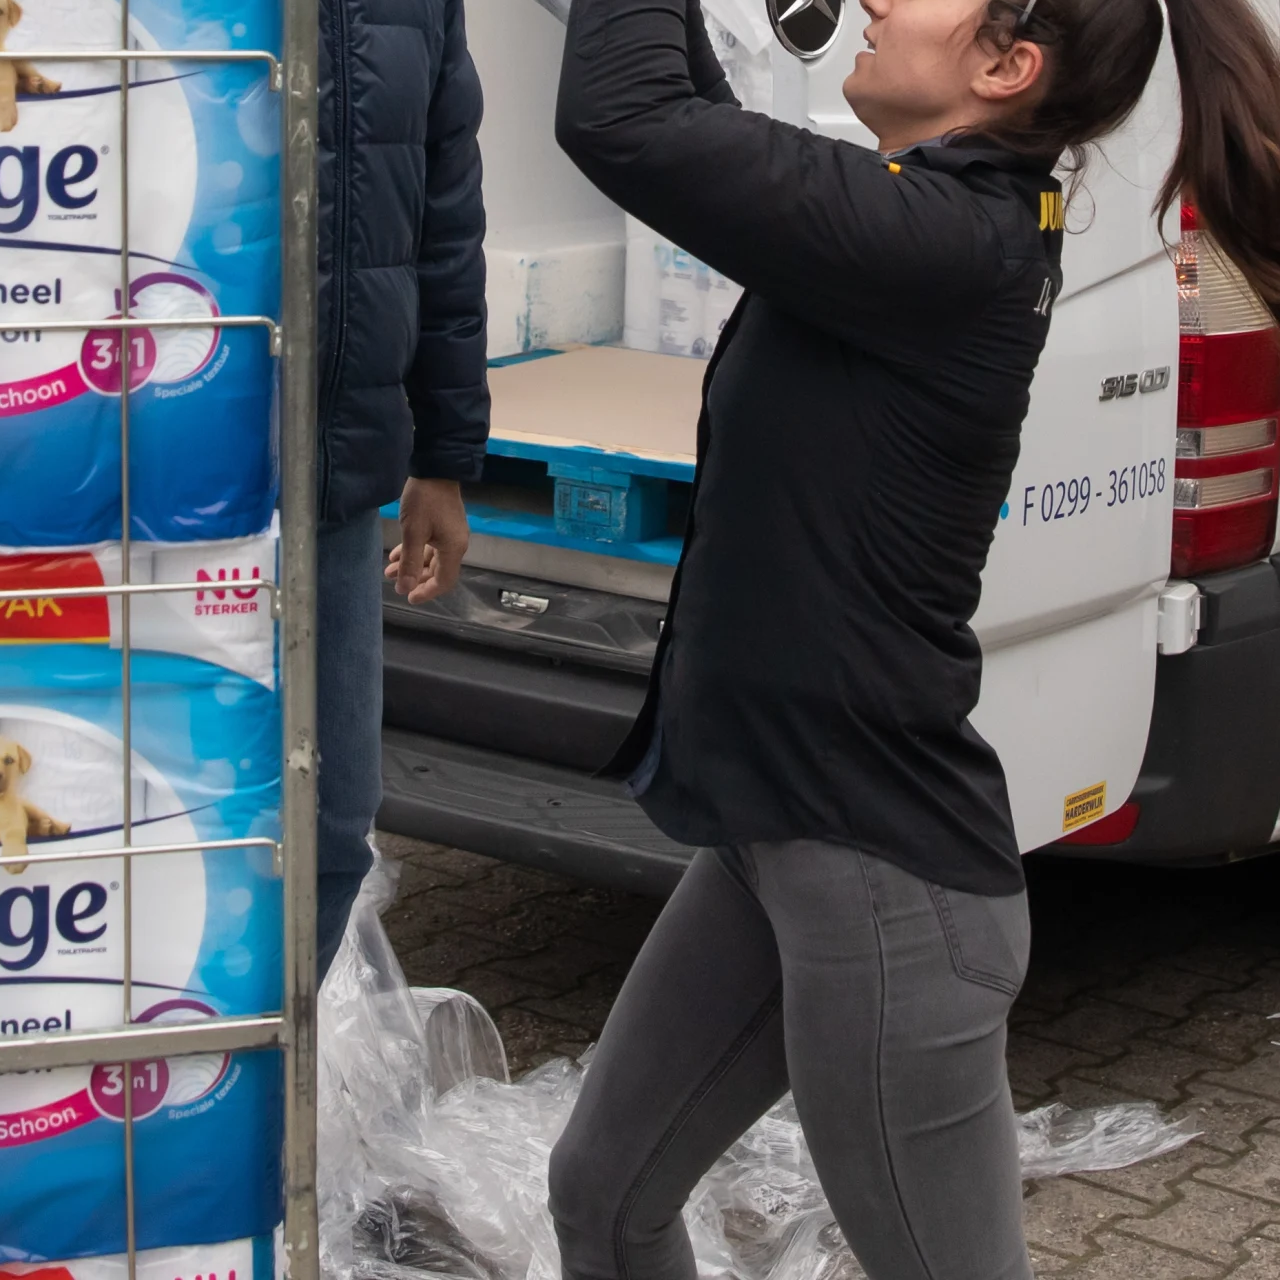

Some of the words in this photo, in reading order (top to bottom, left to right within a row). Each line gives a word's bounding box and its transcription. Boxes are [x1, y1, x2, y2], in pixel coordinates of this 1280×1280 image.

[154, 379, 203, 399] Speciale
[203, 344, 231, 382] textuur
[1023, 485, 1036, 527] F
[1040, 475, 1091, 523] 0299
[1107, 457, 1167, 508] 361058
[193, 601, 260, 617] STERKER
[194, 566, 261, 601] NU
[168, 1098, 215, 1120] Speciale
[215, 1063, 242, 1101] textuur
